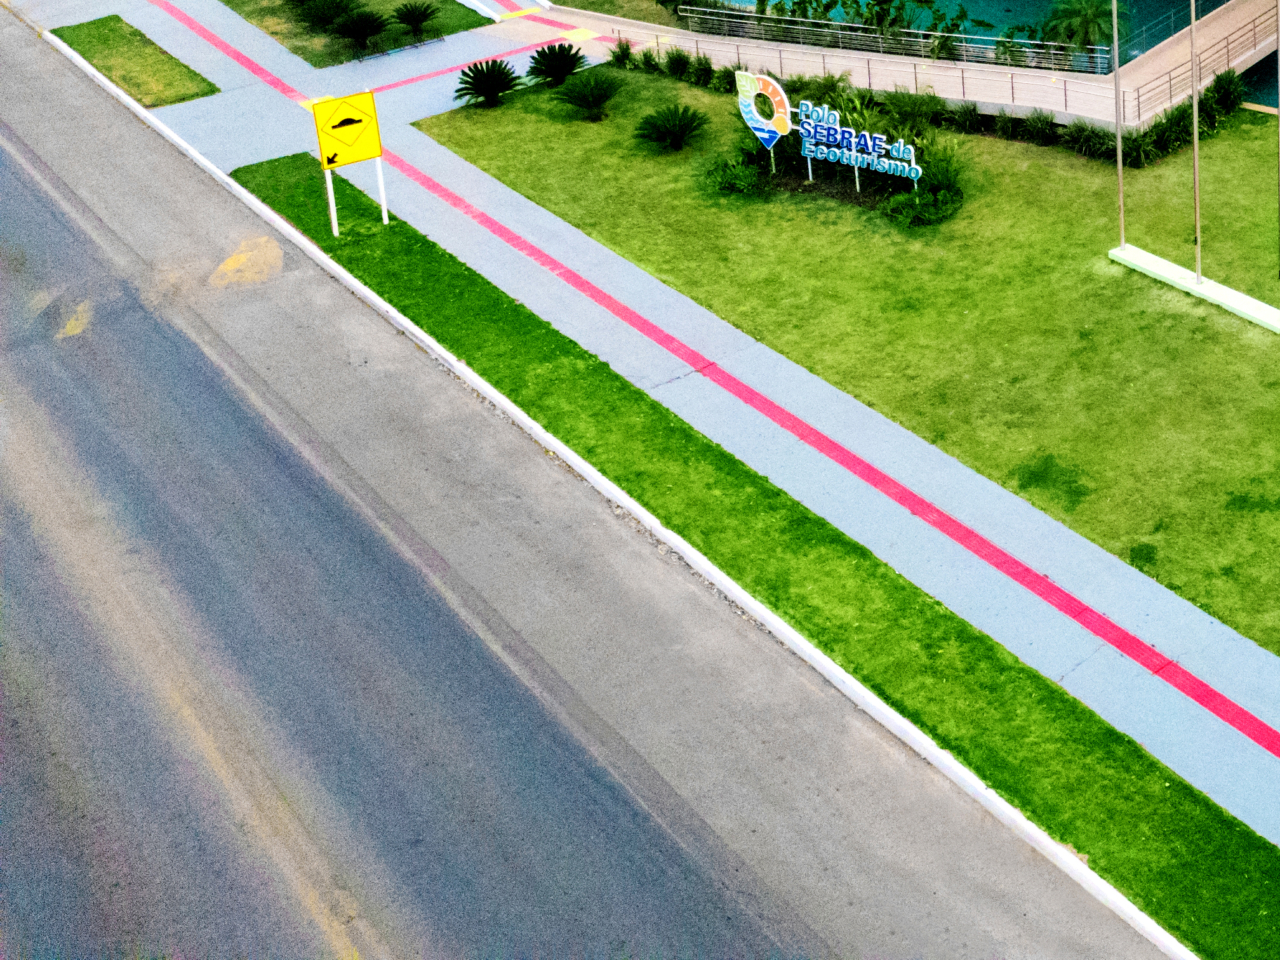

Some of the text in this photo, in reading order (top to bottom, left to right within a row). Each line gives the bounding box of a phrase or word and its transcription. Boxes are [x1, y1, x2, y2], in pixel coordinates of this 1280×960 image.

[800, 100, 839, 125] Polo
[800, 120, 914, 160] SEBRAE de
[801, 139, 922, 180] Ecoturismo
